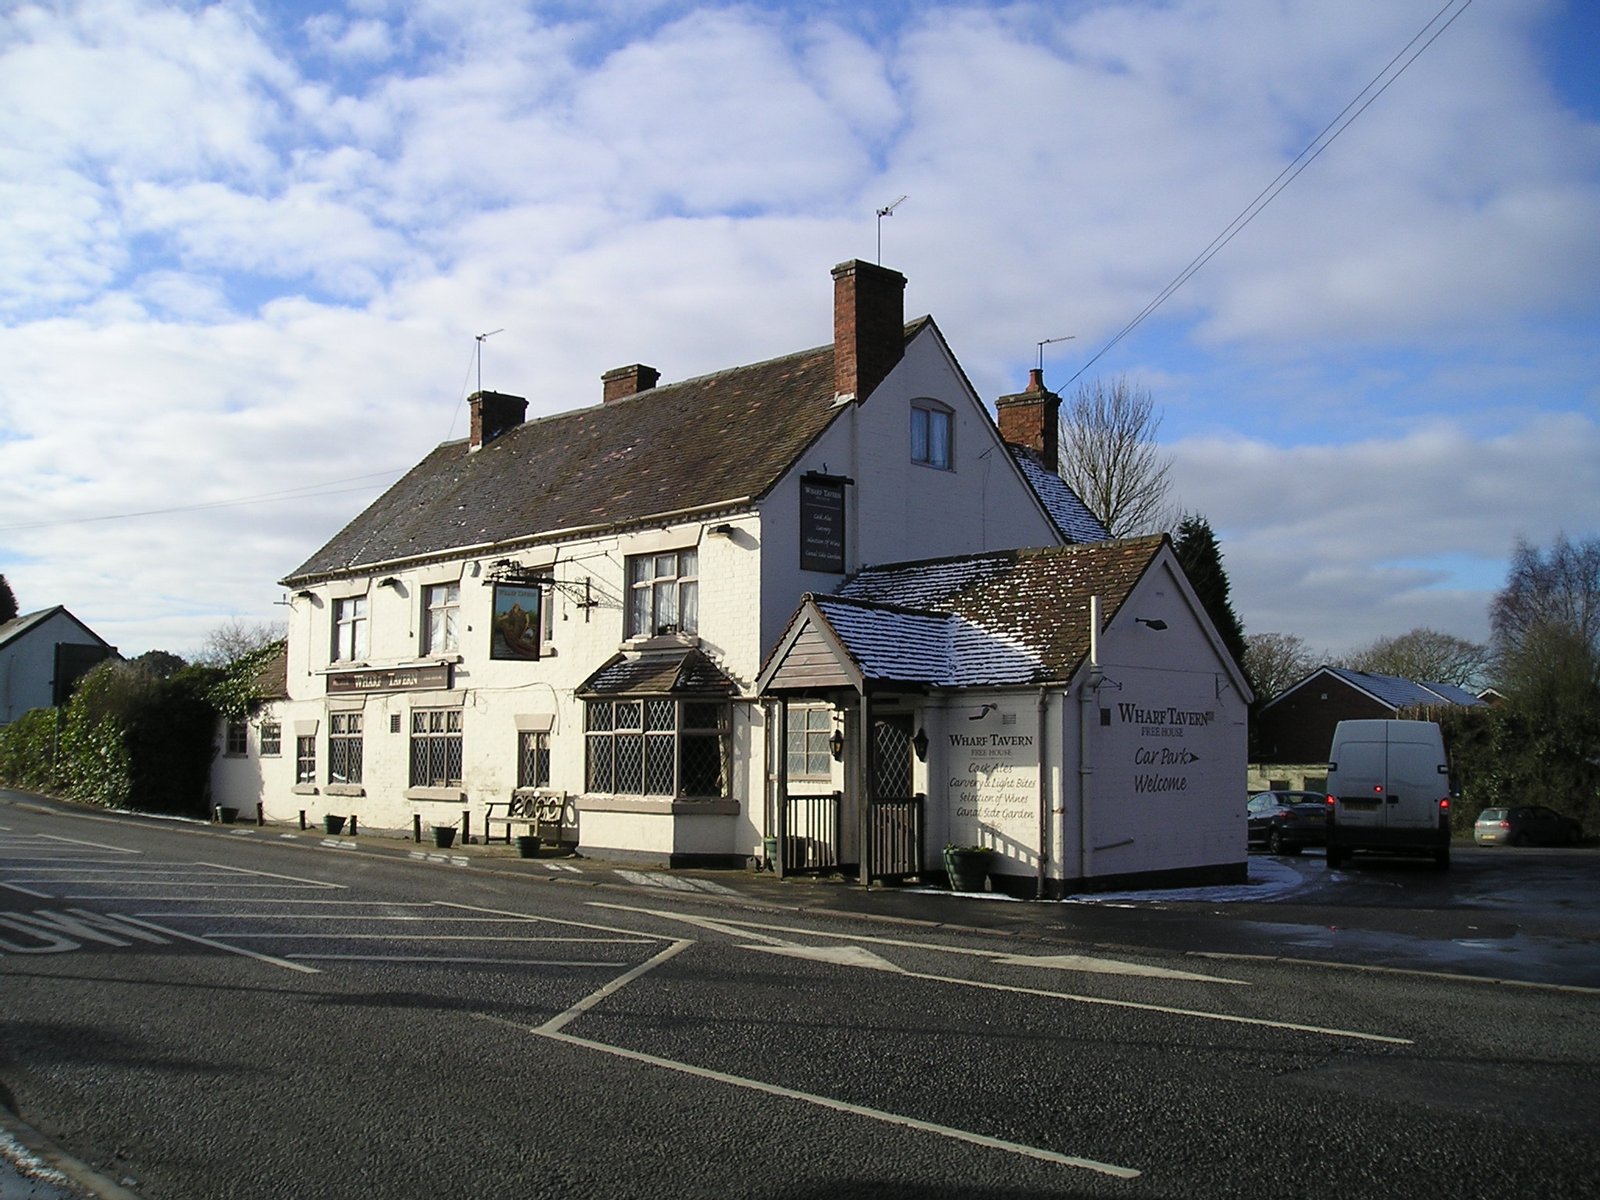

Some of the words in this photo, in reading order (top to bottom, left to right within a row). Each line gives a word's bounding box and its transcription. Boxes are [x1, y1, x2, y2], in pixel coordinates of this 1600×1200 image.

[354, 674, 382, 688] WHARF
[387, 672, 418, 686] TAVERN
[1118, 703, 1166, 725] WHARF
[1167, 708, 1208, 726] TAVERN
[1142, 727, 1160, 736] FREE
[1162, 728, 1184, 737] HOUSE
[949, 734, 988, 746] WHARF
[990, 734, 1033, 746] TAVERN
[1135, 747, 1159, 765] Car
[1160, 748, 1189, 765] Park
[968, 762, 990, 774] Cask
[991, 763, 1014, 773] Ales
[950, 778, 984, 791] Carvery
[992, 778, 1014, 792] Light
[1016, 778, 1036, 788] Bites
[1134, 774, 1188, 794] Welcome
[960, 792, 994, 802] Selection
[994, 794, 1004, 806] of
[1004, 794, 1028, 803] Wines
[956, 808, 981, 817] Canal
[983, 808, 1000, 818] Side
[1002, 809, 1034, 819] Garden
